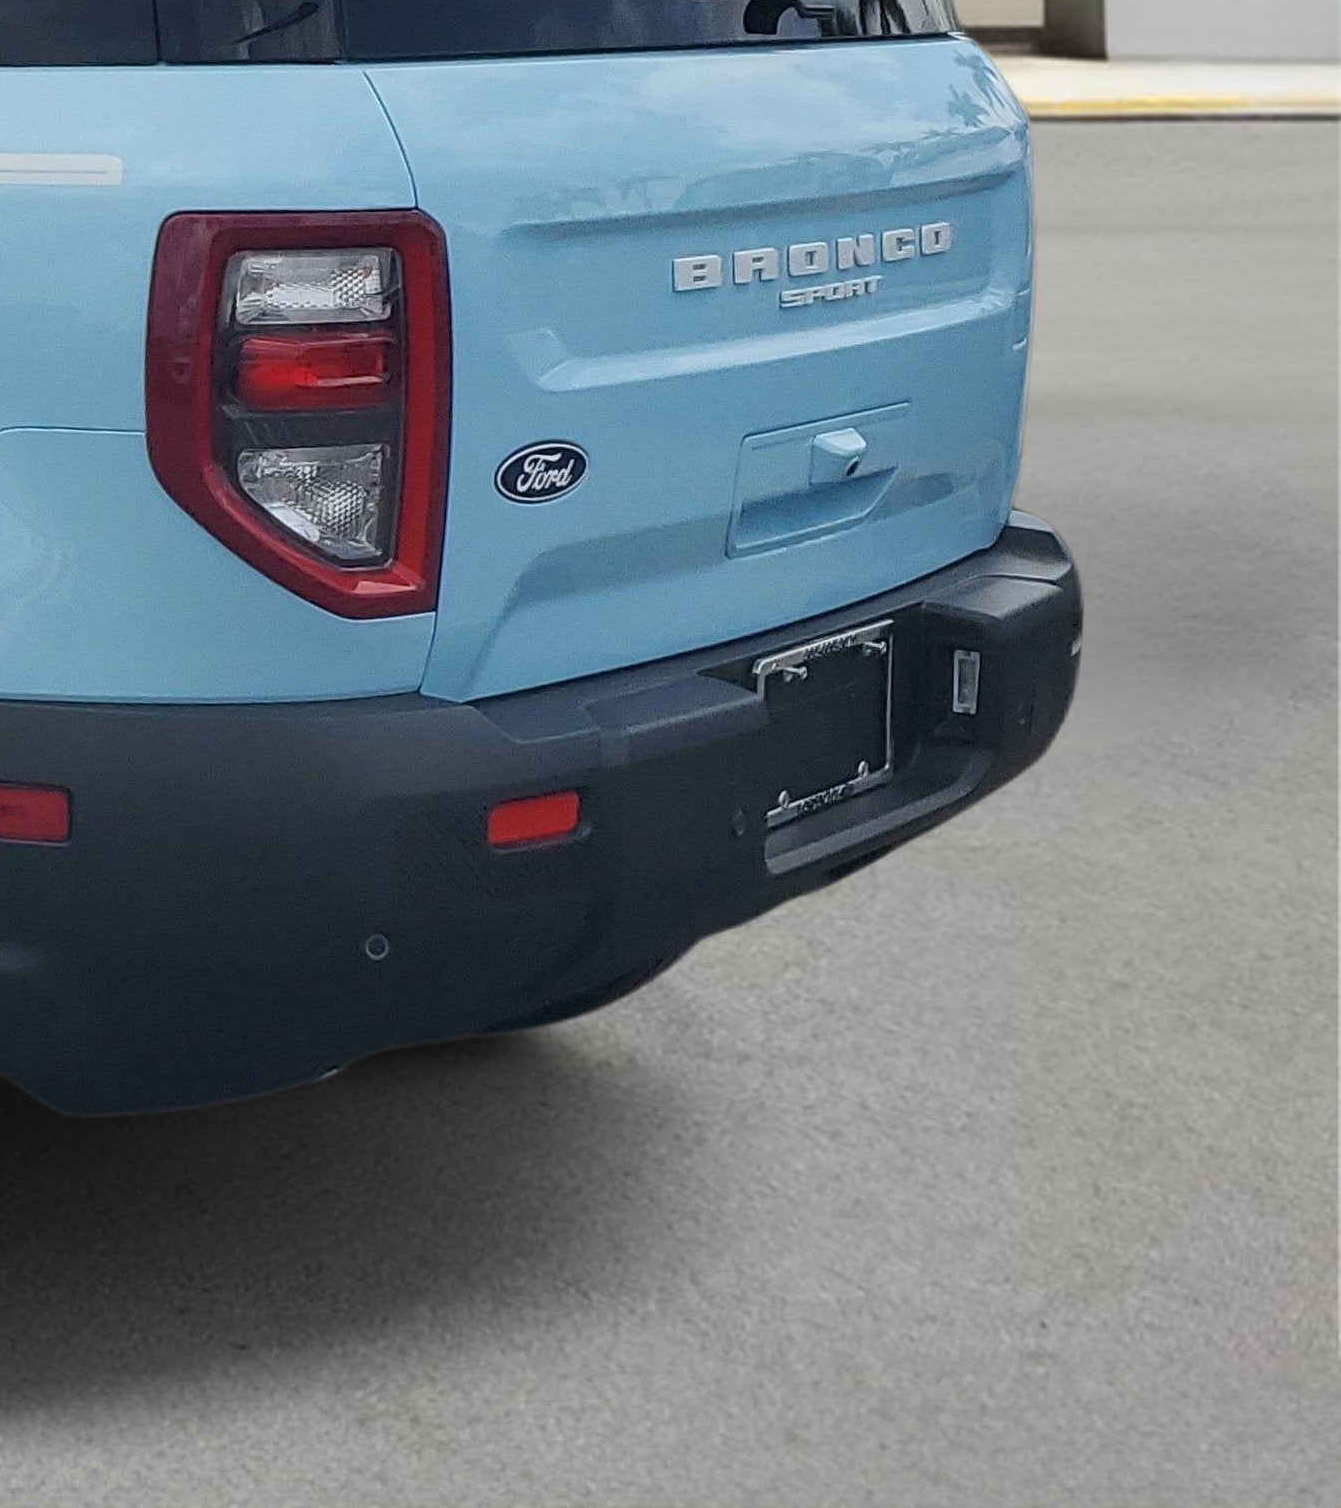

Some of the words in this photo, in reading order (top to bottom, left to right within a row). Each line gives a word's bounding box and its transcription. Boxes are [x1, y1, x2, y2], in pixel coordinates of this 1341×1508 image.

[672, 222, 952, 292] BRONCO
[779, 275, 883, 308] SPORT
[516, 451, 574, 493] Ford
